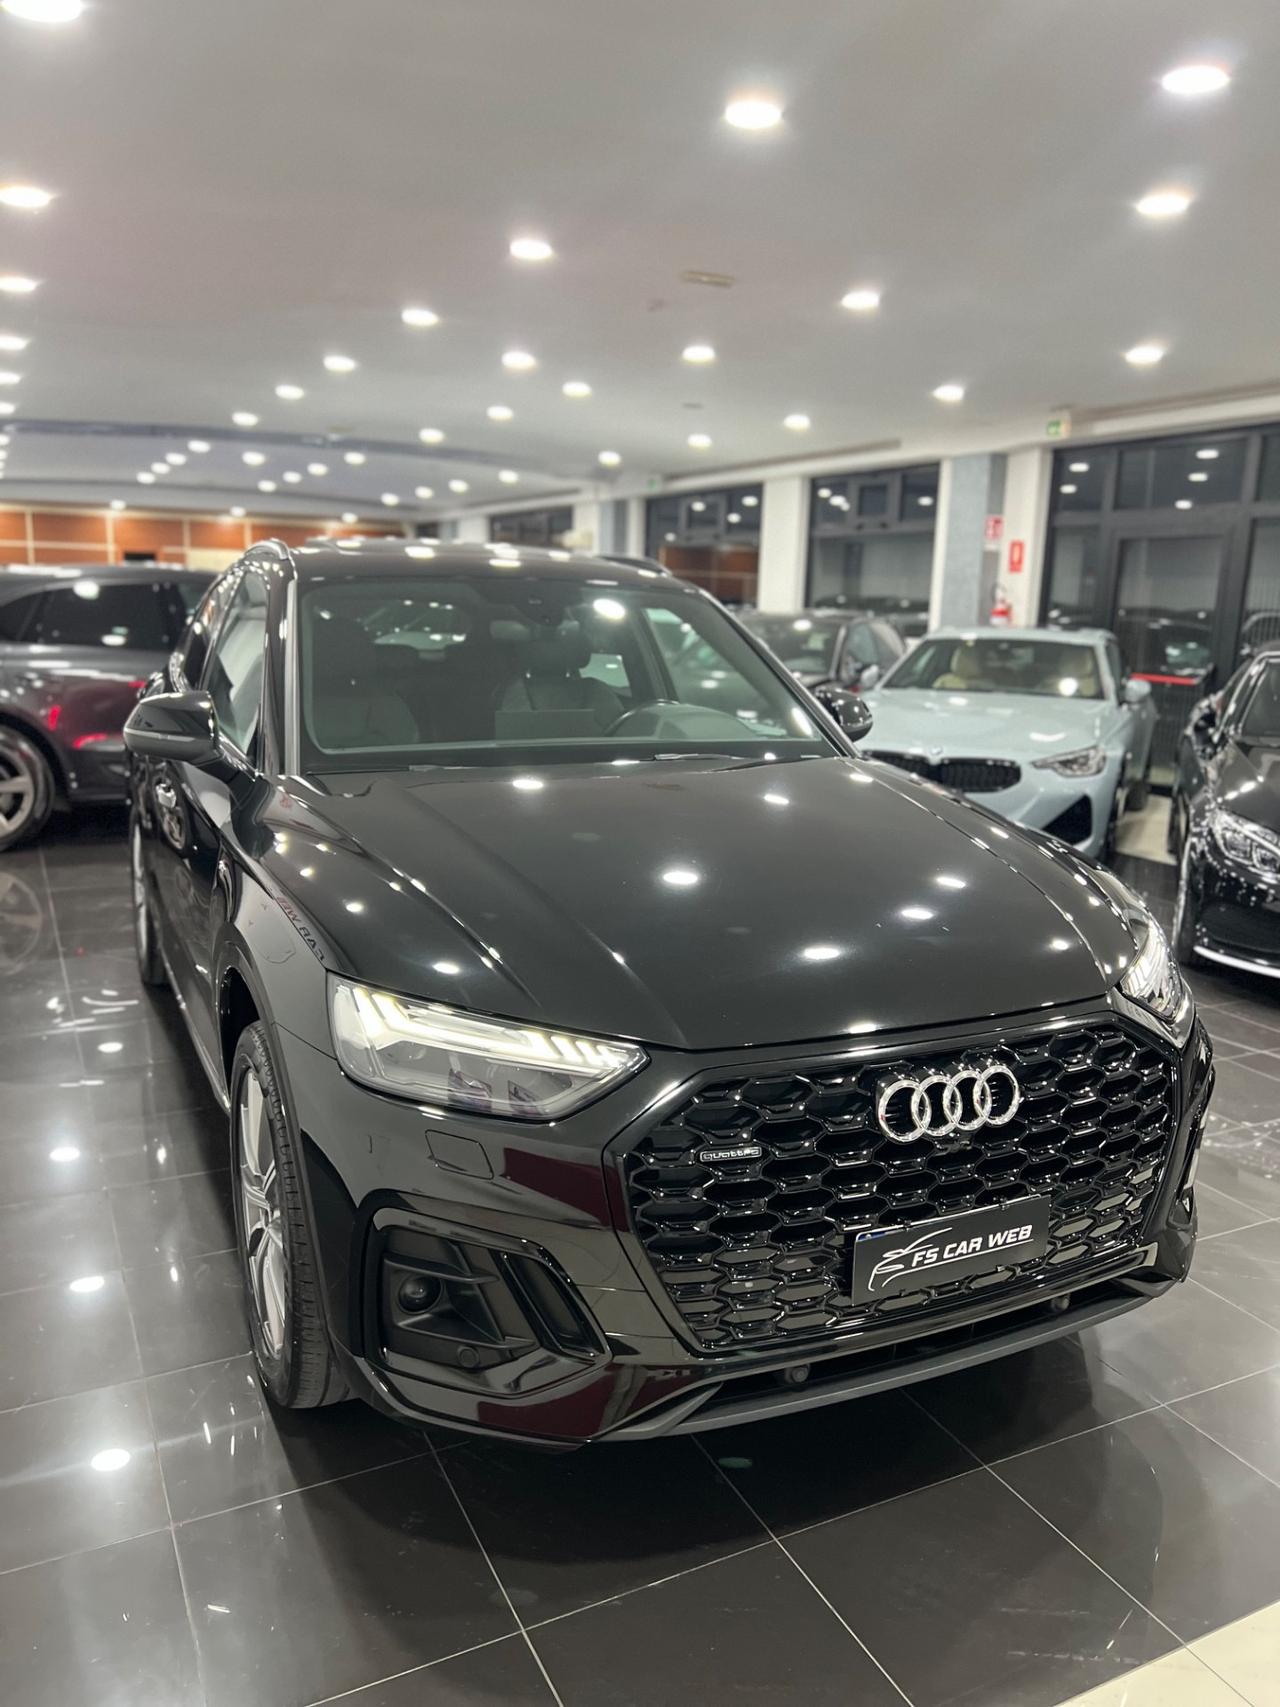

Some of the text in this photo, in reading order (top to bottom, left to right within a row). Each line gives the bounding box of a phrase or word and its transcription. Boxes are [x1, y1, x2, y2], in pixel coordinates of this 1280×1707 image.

[702, 1148, 760, 1161] quattro
[911, 1224, 1033, 1267] FS CAR WEB
